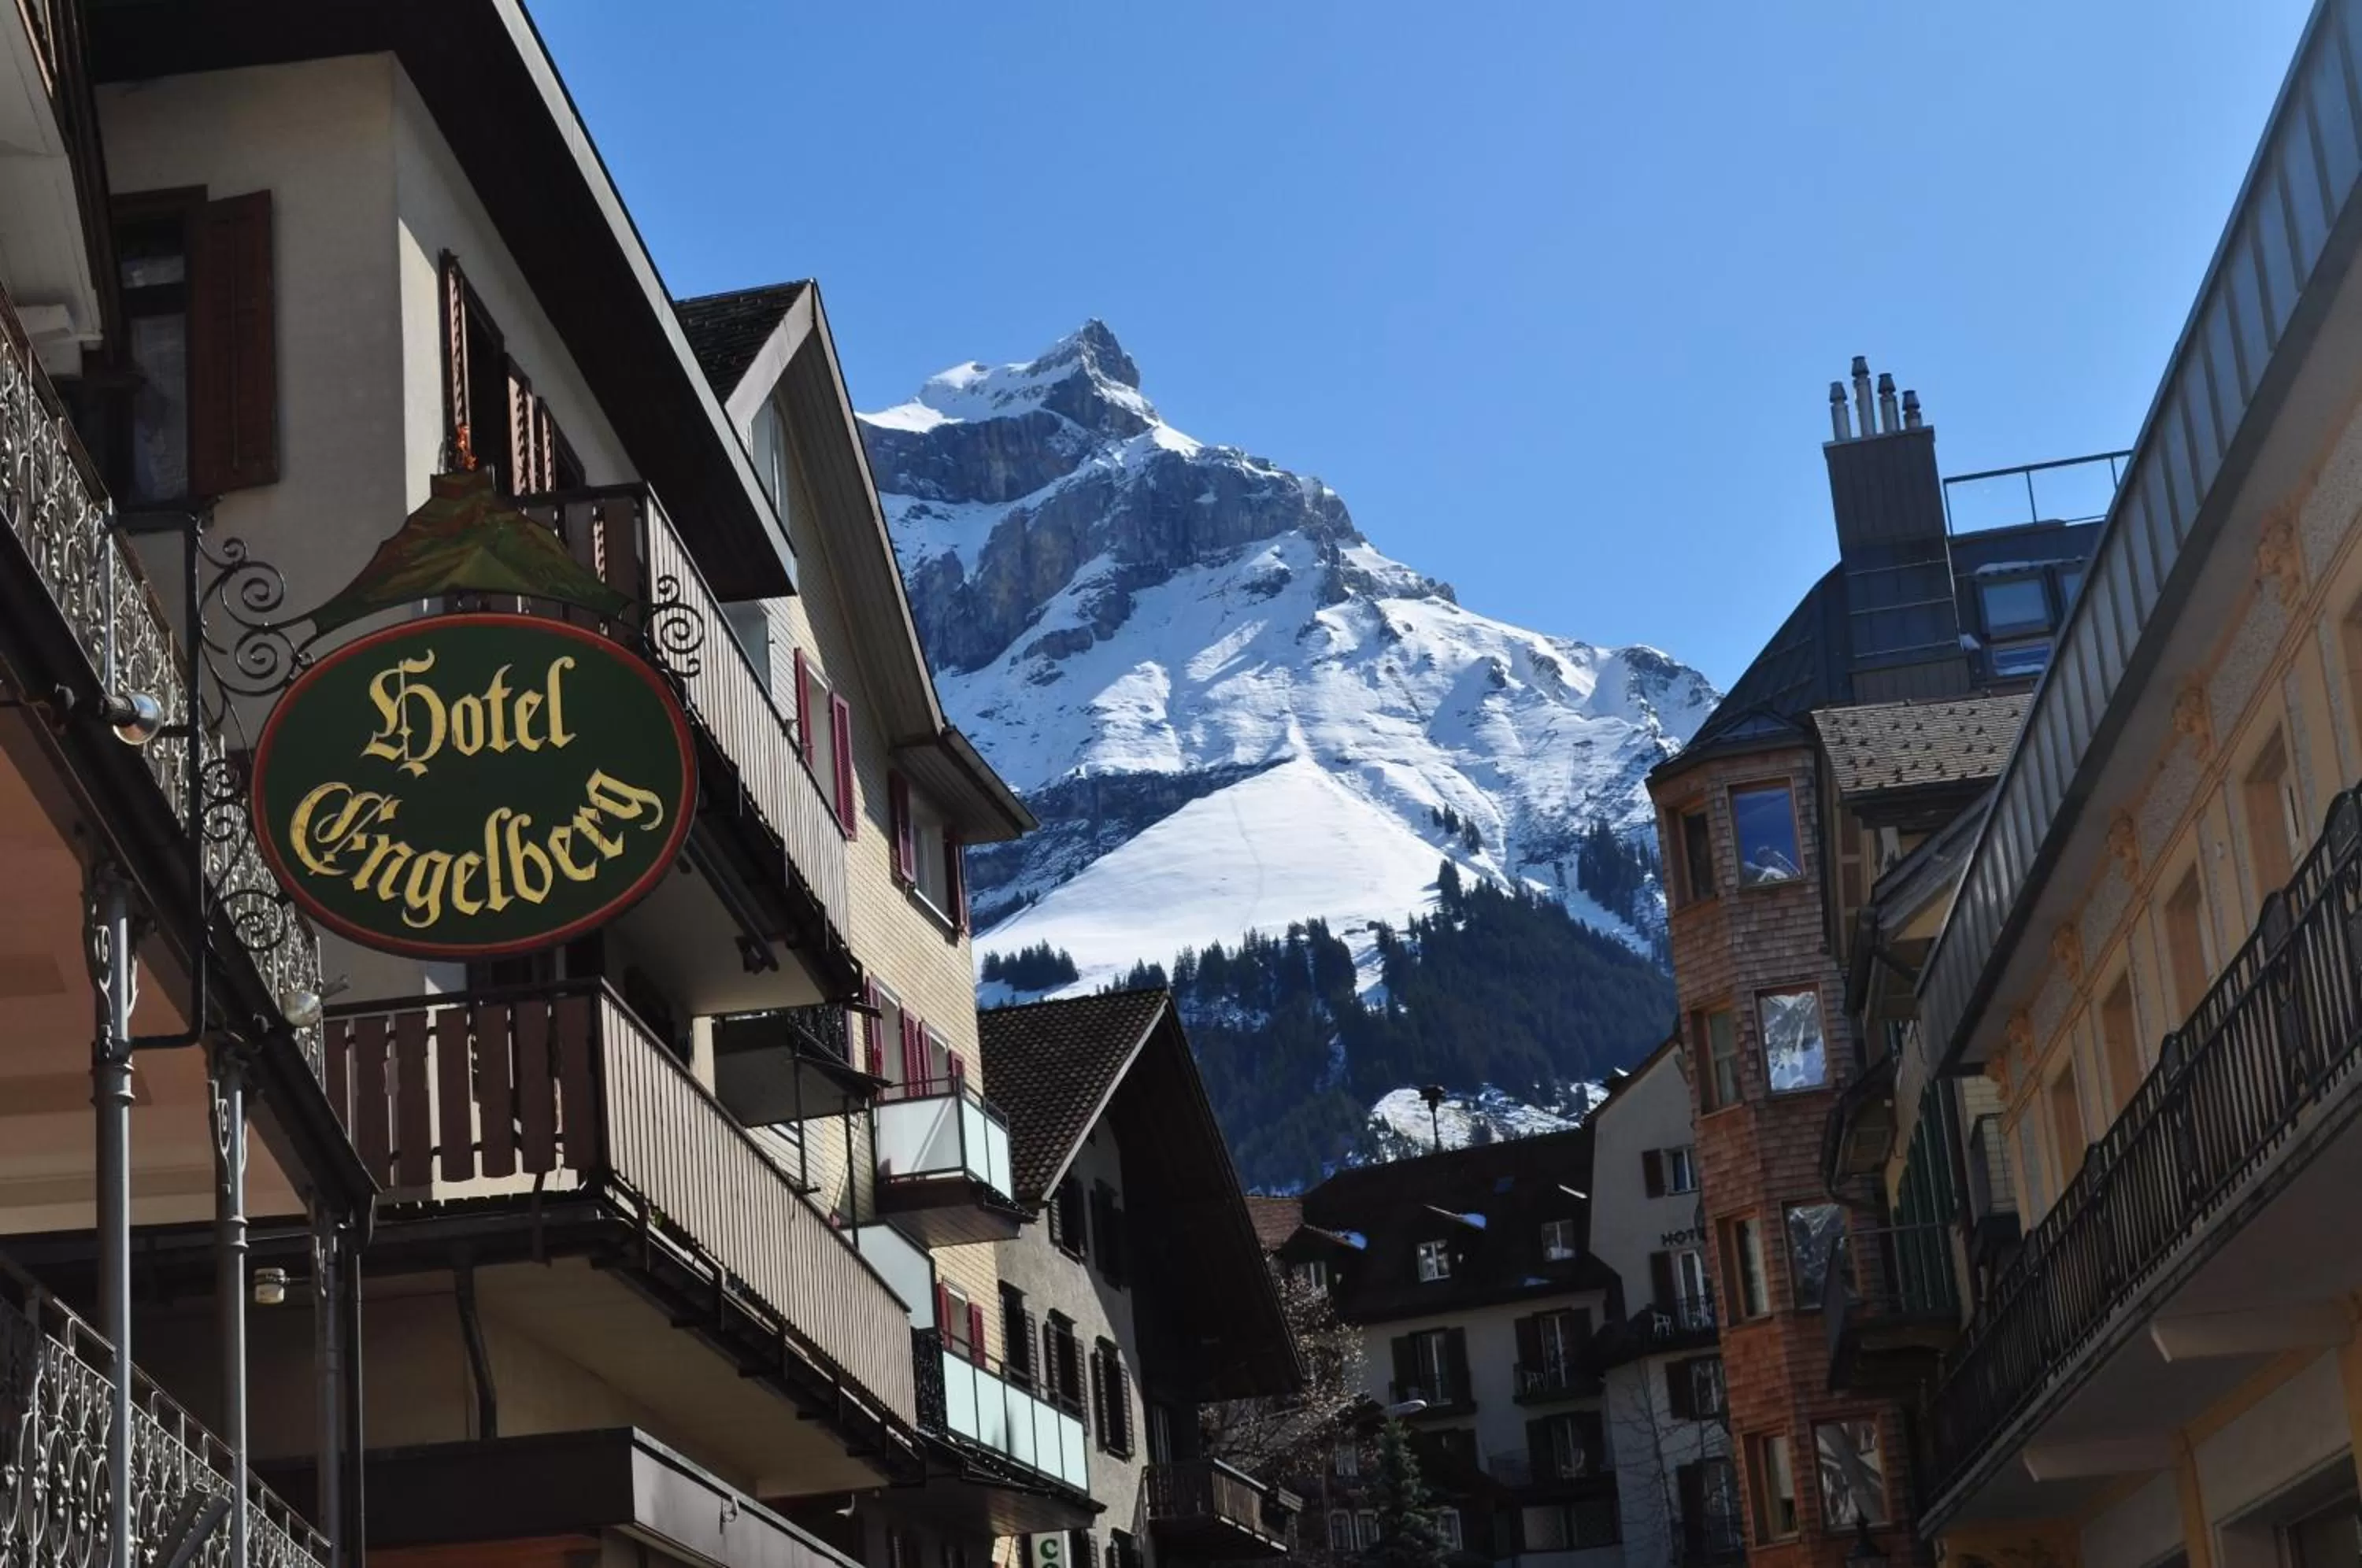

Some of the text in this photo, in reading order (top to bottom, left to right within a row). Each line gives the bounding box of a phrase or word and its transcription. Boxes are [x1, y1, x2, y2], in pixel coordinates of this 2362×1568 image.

[359, 649, 576, 778] Hotel
[290, 768, 664, 928] Engelberg
[1039, 1538, 1061, 1568] C
